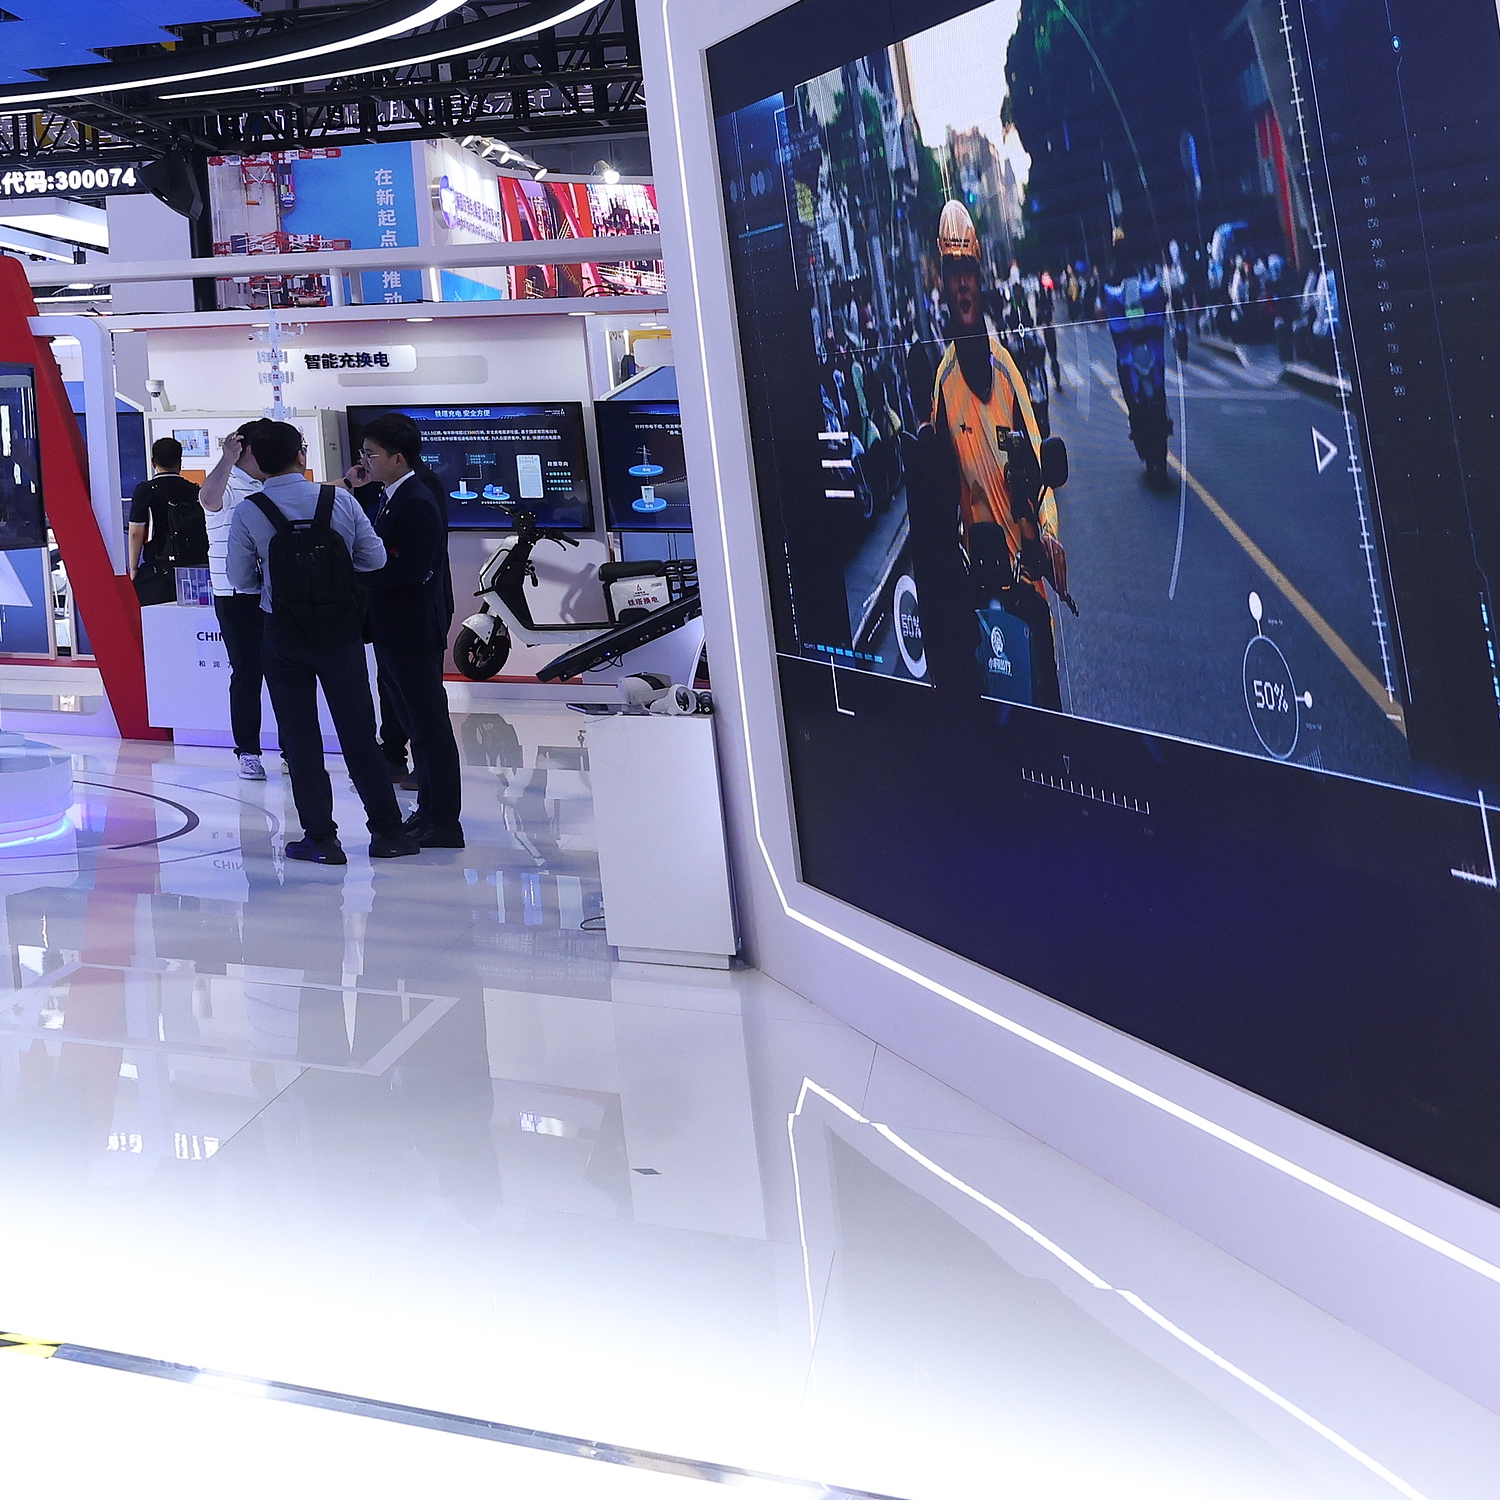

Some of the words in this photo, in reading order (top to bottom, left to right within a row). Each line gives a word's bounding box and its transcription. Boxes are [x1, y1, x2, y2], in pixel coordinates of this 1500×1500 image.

[304, 352, 389, 370] 智能充换电
[1253, 679, 1289, 713] 50%
